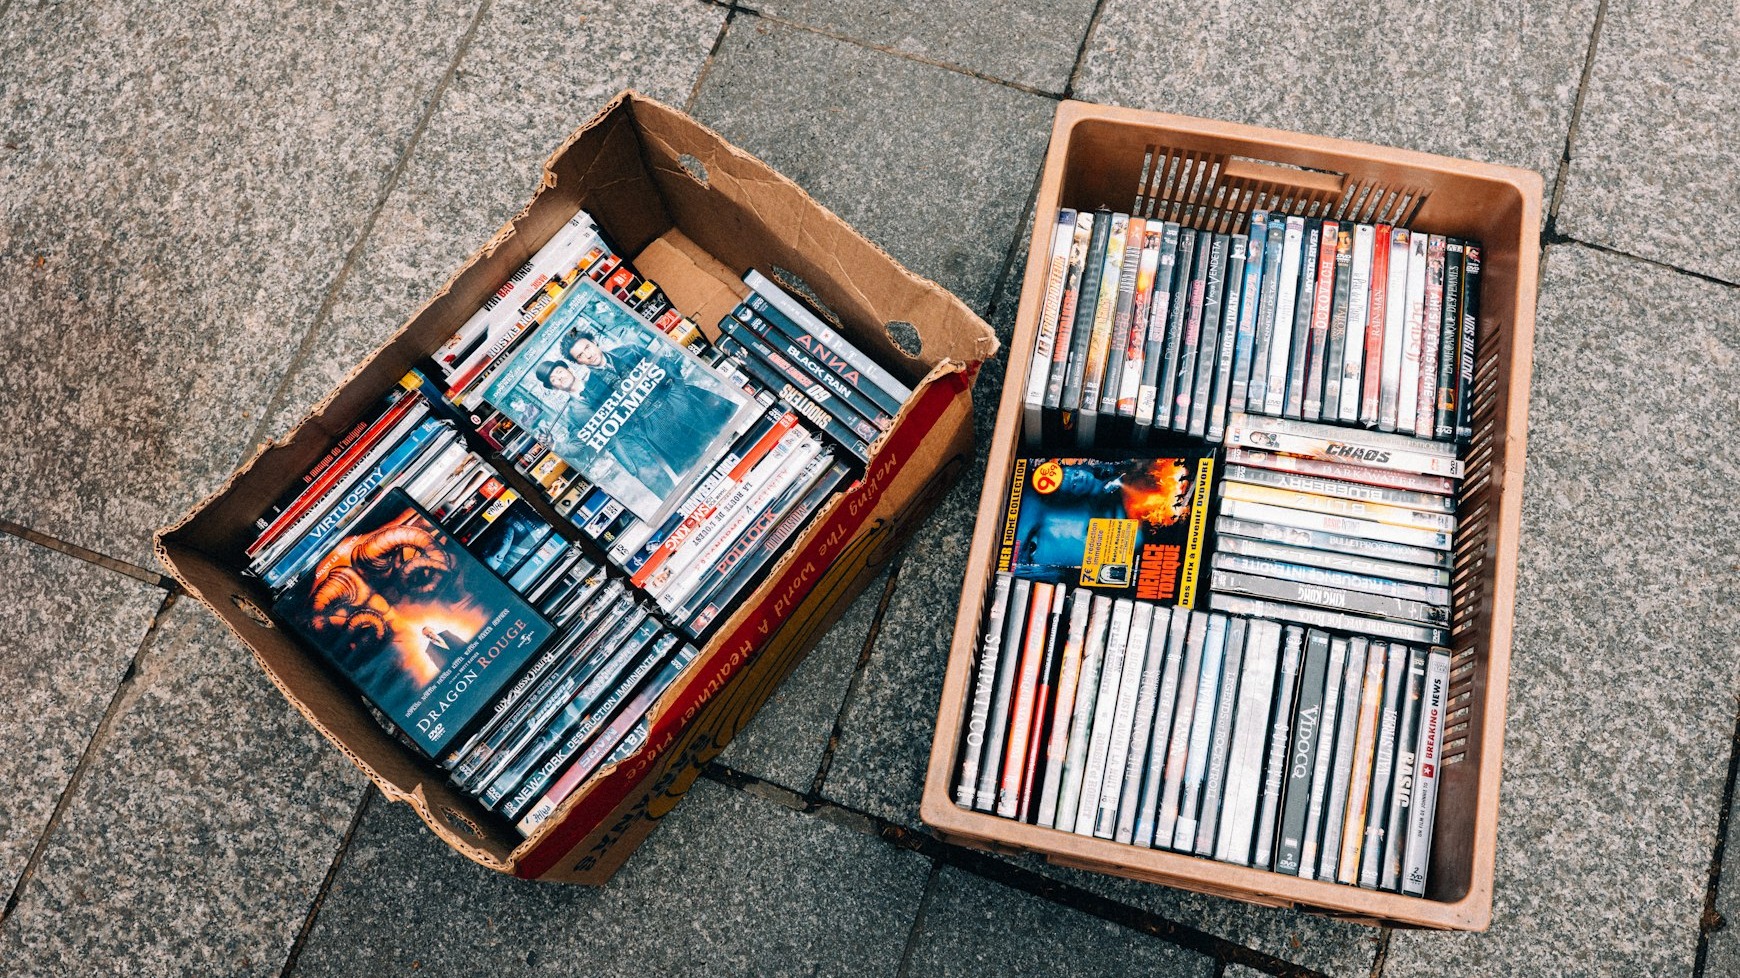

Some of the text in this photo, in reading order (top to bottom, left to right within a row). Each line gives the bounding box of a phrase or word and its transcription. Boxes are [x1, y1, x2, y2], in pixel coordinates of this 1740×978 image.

[1208, 240, 1223, 285] VENDETTA
[1304, 229, 1319, 293] MYSTIC RIVER
[482, 292, 501, 312] VERY
[496, 280, 514, 298] BAD
[517, 293, 553, 328] MISSION
[1036, 255, 1065, 357] LE TRANSPORTEUR
[1205, 297, 1217, 306] V
[1371, 289, 1383, 336] RAIN MAN
[1429, 313, 1438, 323] SI
[485, 323, 521, 359] EVASION
[1460, 314, 1476, 383] INTO THE SUN
[785, 344, 825, 378] BLACK
[822, 372, 851, 398] RAIN
[1423, 365, 1435, 396] RICHE
[575, 355, 654, 442] SHERLOCK
[584, 363, 668, 454] HOLMES
[777, 382, 833, 430] SHOOTERS
[1325, 442, 1392, 463] CHAOS
[742, 481, 752, 492] LA
[1009, 459, 1025, 515] COLLECTION
[1277, 475, 1382, 499] BLUEBERRY
[1322, 466, 1362, 479] DARK
[1368, 472, 1416, 486] WATER
[308, 467, 386, 540] VIRTUOSITY
[713, 511, 725, 523] DE
[723, 491, 743, 512] ROUTE
[1294, 494, 1365, 514] BLITZ
[715, 508, 777, 575] POLLOCK
[763, 503, 809, 552] MOSQUITO
[1004, 516, 1016, 543] HOME
[1189, 509, 1202, 549] devenir
[1136, 542, 1164, 599] MENACE
[1158, 543, 1181, 600] TOXIQUE
[1185, 561, 1195, 582] prix
[1240, 559, 1305, 577] INTERDITE
[1181, 585, 1191, 605] Des
[1297, 586, 1322, 602] KONG
[1322, 591, 1345, 606] KING
[625, 452, 901, 781] Making The World A Healthier Place
[416, 617, 527, 732] DRAGON ROUGE
[1220, 671, 1235, 718] LEGENDS
[426, 722, 443, 739] DVD
[513, 749, 567, 805] NEW-YORK
[565, 695, 617, 749] DESTRUCTION
[616, 653, 657, 699] IMMINENTE
[1425, 676, 1441, 758] BREAKING NEWS
[577, 726, 618, 768] MARS
[1150, 711, 1168, 772] AMERICAN
[1290, 703, 1317, 780] VIDOCQ
[1375, 707, 1397, 775] WALL STREET
[1311, 804, 1322, 816] LE
